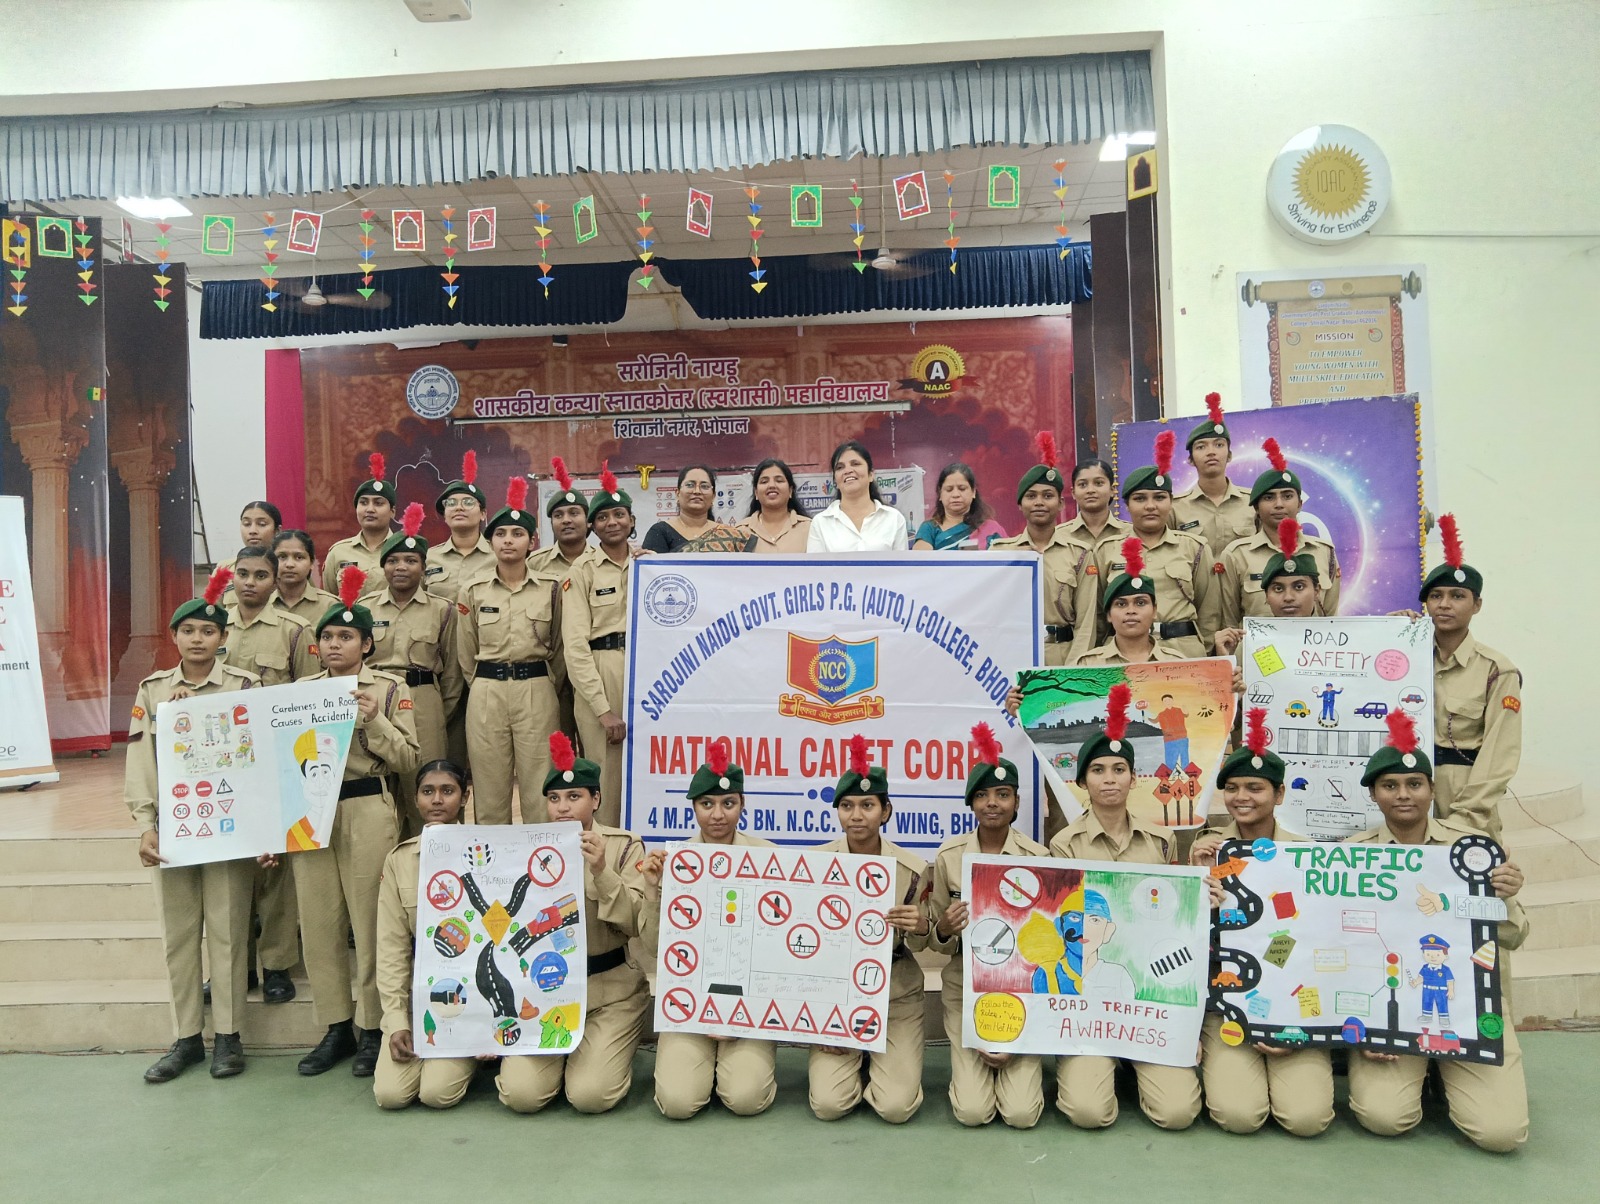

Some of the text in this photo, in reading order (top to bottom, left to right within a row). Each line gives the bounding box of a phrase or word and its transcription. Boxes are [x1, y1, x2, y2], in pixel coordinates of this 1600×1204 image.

[1287, 200, 1378, 234] Striving for Eminence
[1315, 332, 1354, 341] MISSION
[1321, 349, 1363, 358] EMPOWER
[617, 353, 740, 384] सरोजिनी नायडू
[930, 361, 946, 380] A
[1294, 360, 1379, 371] YOUNG WOMEN WITH
[1315, 373, 1338, 382] SKILL
[1339, 371, 1385, 381] EDUCATION
[924, 383, 952, 391] NAAC
[1328, 385, 1346, 393] AND
[474, 389, 551, 418] शासकीय
[554, 394, 601, 414] कन्या
[604, 384, 694, 412] स्नातकोत्तर
[698, 379, 781, 409] (स्वशासी)
[784, 376, 890, 405] महाविद्यालय
[613, 417, 664, 439] शिवाजी
[703, 416, 749, 435] भोपाल
[877, 476, 897, 489] भियान
[801, 498, 833, 509] EARNIN
[1303, 628, 1349, 647] ROAD
[641, 643, 701, 721] SAROJINI
[695, 610, 740, 661] NAIDU
[740, 591, 782, 631] GOVT.
[784, 582, 825, 616] GIRLS
[830, 582, 856, 612] P.G.
[862, 585, 915, 633] (AUTO.)
[915, 605, 979, 675] COLLEGE,
[974, 656, 1018, 729] BHOL
[1297, 650, 1372, 671] SAFETY
[0, 661, 30, 671] ment
[818, 661, 847, 680] NCC
[323, 698, 335, 708] On
[800, 705, 864, 720] एकता और अनुशासन
[270, 708, 354, 729] Causes Accidents
[904, 738, 1004, 781] CORP
[173, 786, 189, 796] STOP
[176, 807, 188, 816] 50
[223, 819, 233, 832] P
[648, 806, 658, 829] 4
[663, 807, 696, 830] M.P.
[754, 809, 781, 832] BN.
[787, 809, 837, 834] N.C.C.
[896, 811, 946, 839] WING,
[427, 838, 451, 853] ROAD
[526, 831, 563, 846] TRAFFIC
[1284, 846, 1424, 873] TRAFFIC
[1305, 869, 1399, 901] RULES
[860, 918, 885, 938] 30
[859, 965, 881, 987] 17
[1047, 997, 1169, 1020] ROAD TRAFFIC
